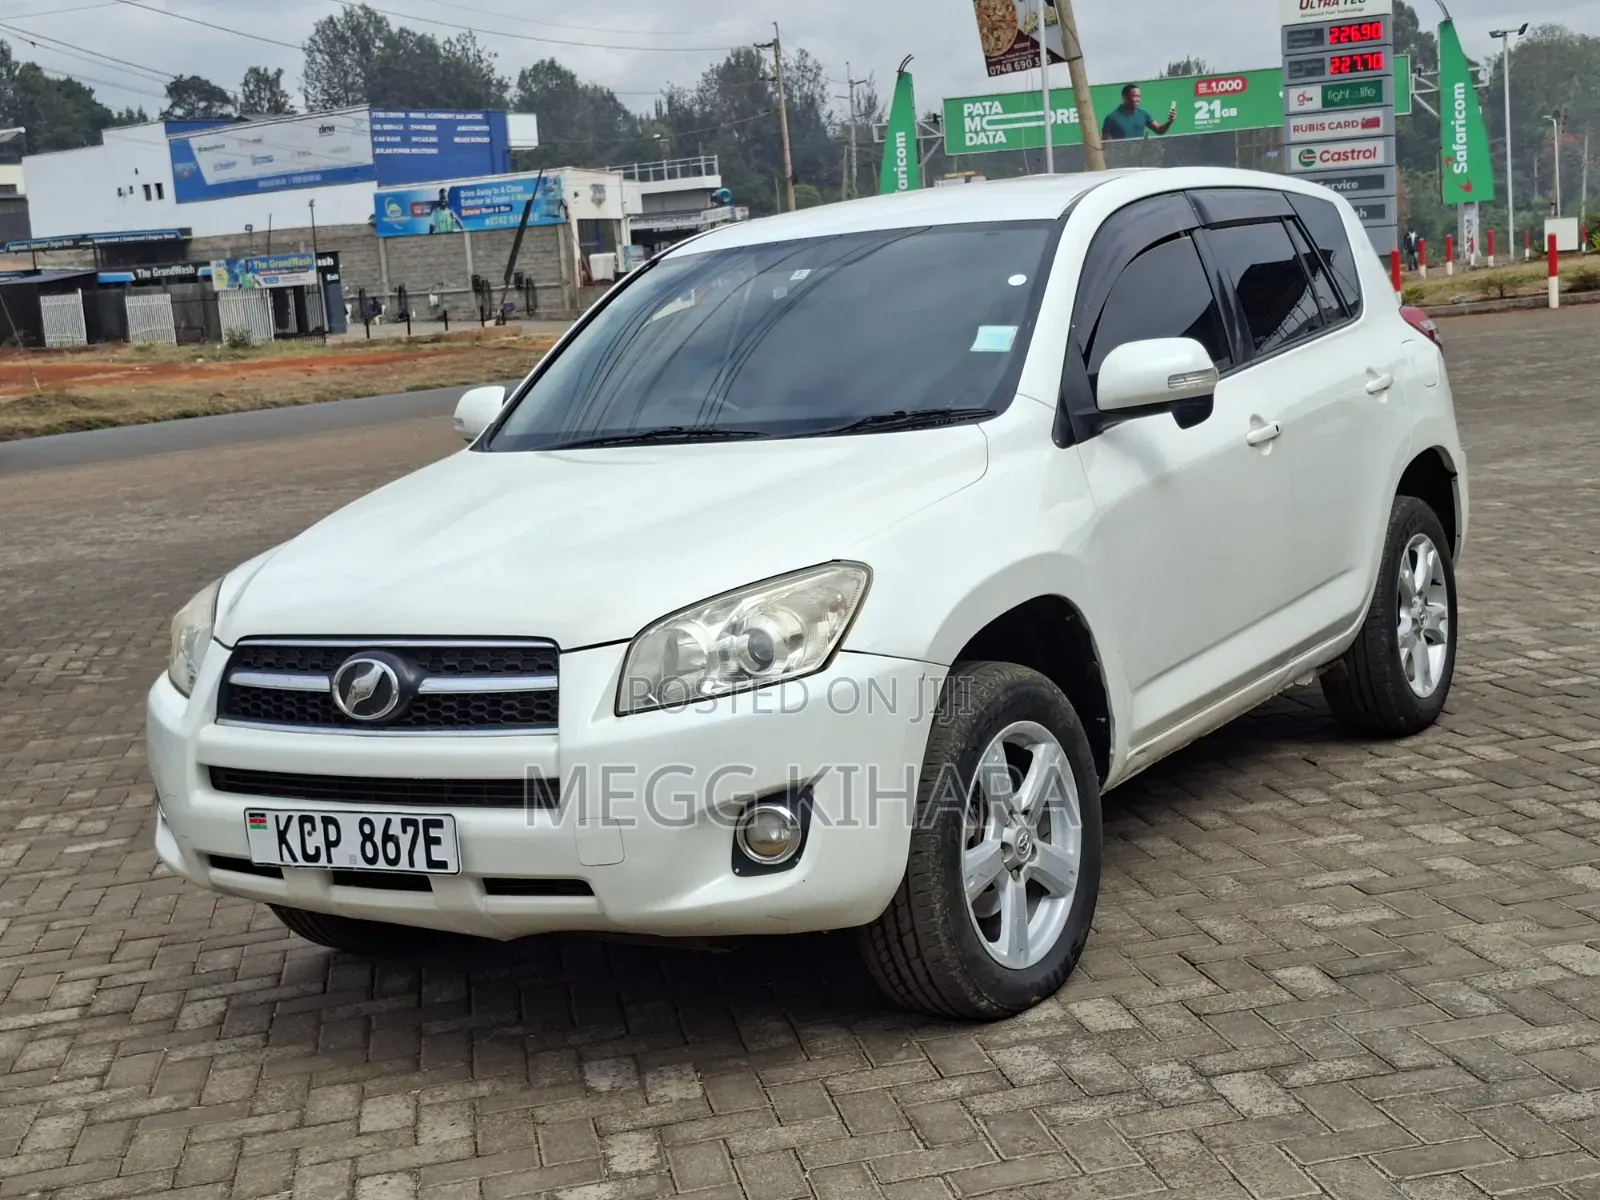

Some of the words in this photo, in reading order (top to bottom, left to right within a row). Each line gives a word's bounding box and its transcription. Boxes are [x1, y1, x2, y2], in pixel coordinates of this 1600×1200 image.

[989, 63, 1013, 76] 0748
[1014, 59, 1033, 71] 690
[1211, 79, 1243, 94] 1,000
[1328, 89, 1350, 102] light
[1360, 86, 1376, 98] life
[963, 101, 1003, 117] PATA
[1293, 122, 1326, 133] RUBIS
[1328, 120, 1359, 131] CARD
[1450, 82, 1468, 174] Safaricom
[965, 131, 1007, 146] DATA
[1319, 146, 1377, 163] Castrol
[136, 268, 151, 279] The
[152, 264, 195, 277] GrandWash
[275, 814, 342, 864] KCP
[358, 816, 449, 871] 867E
